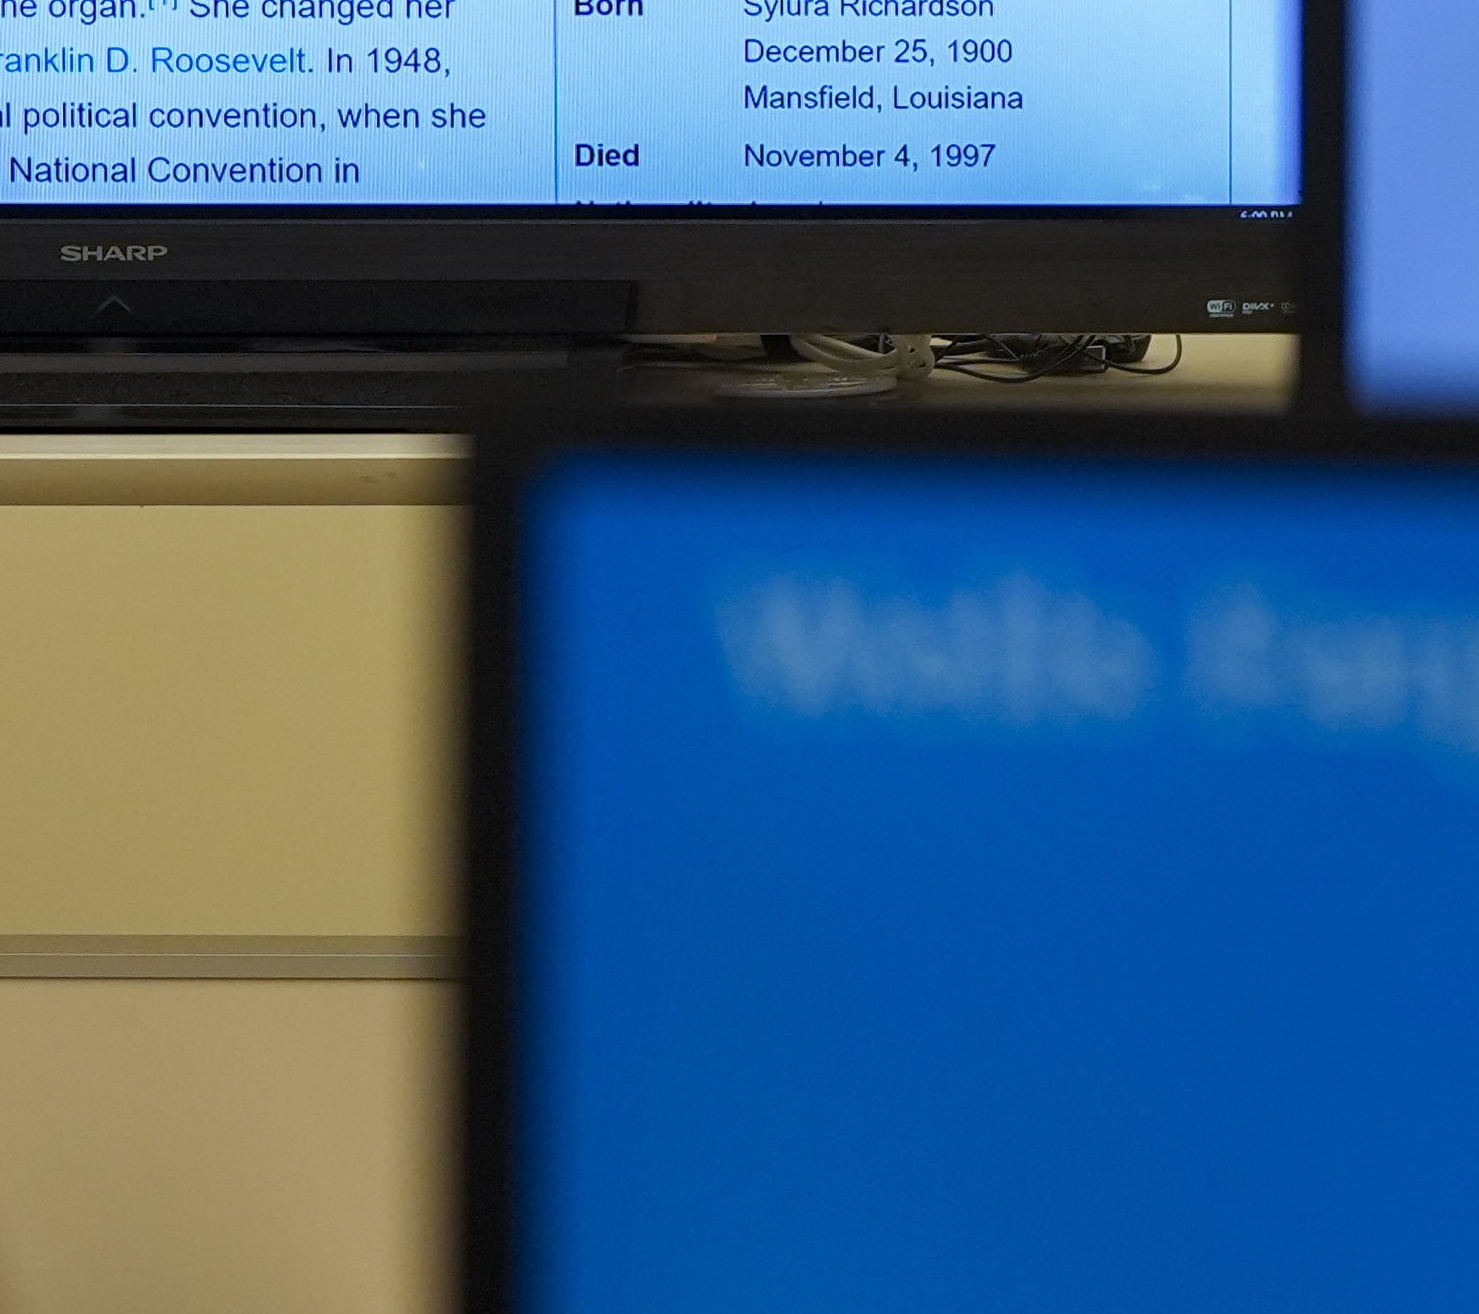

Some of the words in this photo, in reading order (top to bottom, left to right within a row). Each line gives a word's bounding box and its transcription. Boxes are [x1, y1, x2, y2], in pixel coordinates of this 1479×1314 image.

[106, 47, 137, 74] D.
[151, 46, 314, 74] Roosevelt.
[328, 47, 353, 74] In
[367, 46, 450, 78] 1948,
[744, 38, 886, 64] December
[894, 38, 935, 67] 25,
[948, 38, 1013, 64] 1900
[744, 84, 882, 114] Mansfield,
[893, 85, 1023, 110] Louisiana
[575, 143, 640, 167] Died
[744, 143, 886, 168] November
[894, 143, 918, 172] 4,
[931, 143, 997, 168] 1997
[60, 244, 168, 262] SHARP
